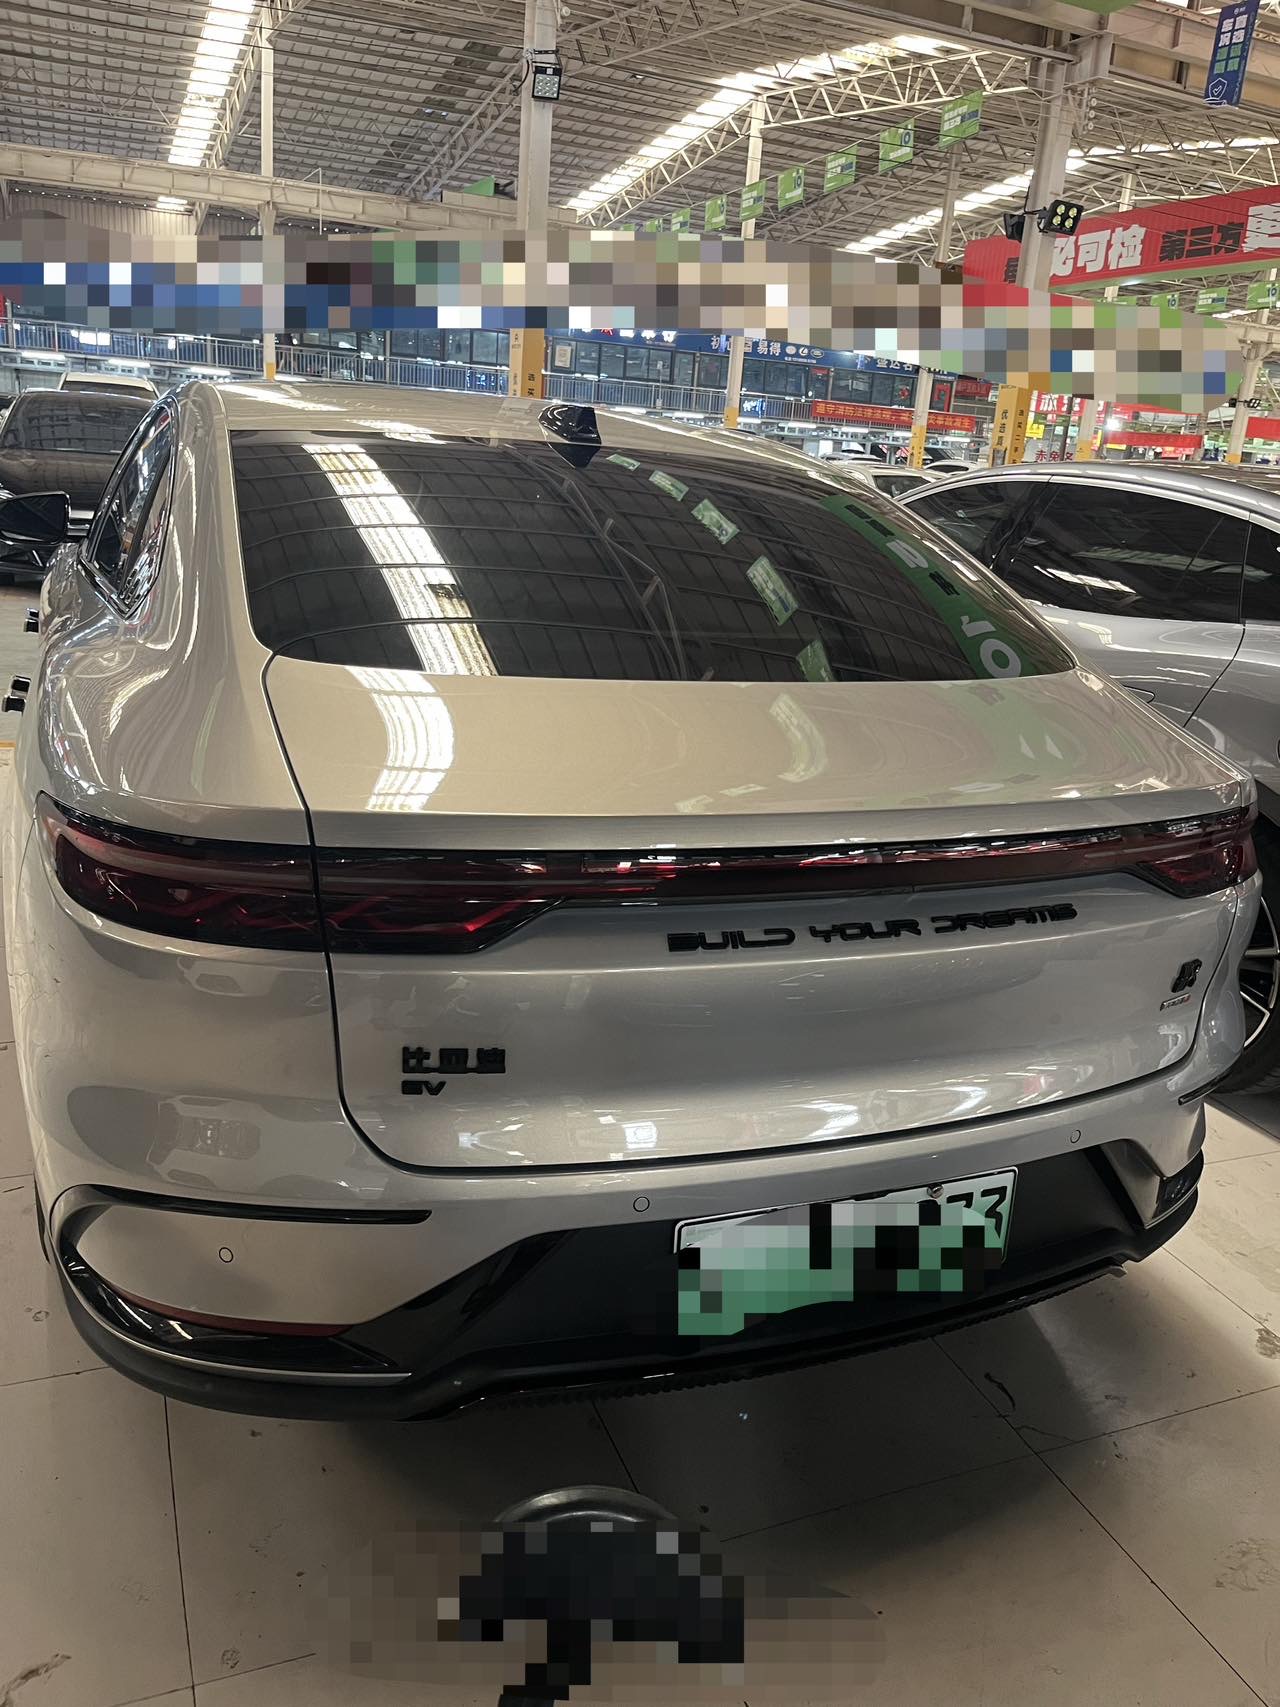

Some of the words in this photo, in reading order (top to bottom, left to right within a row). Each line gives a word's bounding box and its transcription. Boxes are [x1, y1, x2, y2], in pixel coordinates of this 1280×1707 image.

[1159, 221, 1245, 262] 第三方
[667, 927, 796, 952] BUILD
[808, 918, 922, 943] YOUR
[930, 903, 1078, 934] DREAMS
[401, 1080, 447, 1096] EV
